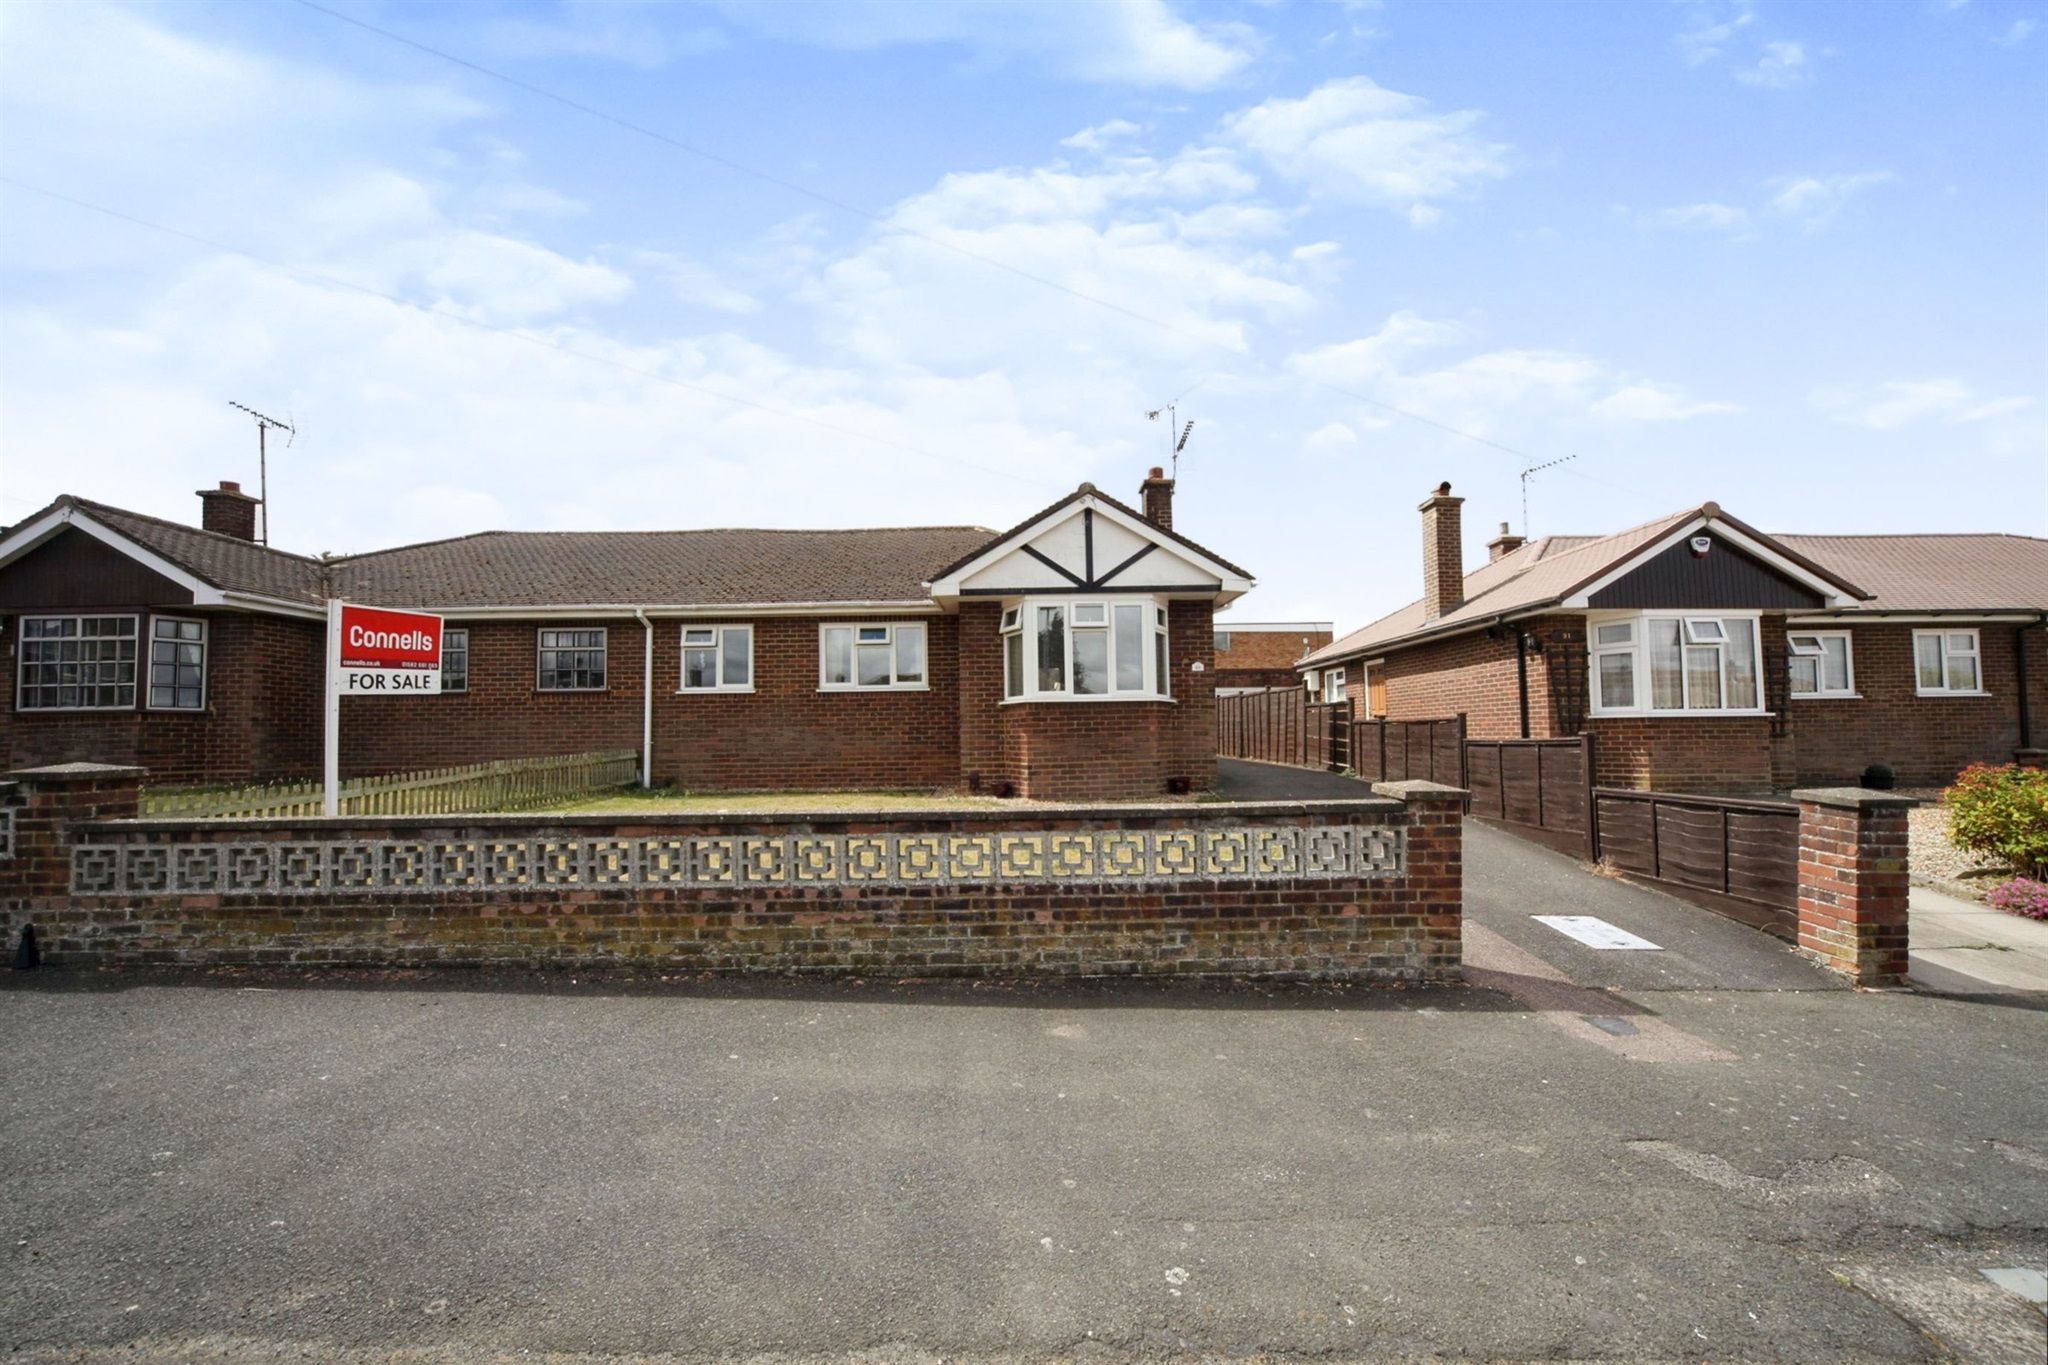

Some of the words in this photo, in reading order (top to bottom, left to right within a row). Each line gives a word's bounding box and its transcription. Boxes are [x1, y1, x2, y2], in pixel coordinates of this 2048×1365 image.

[350, 625, 433, 651] Connells
[349, 673, 386, 689] FOR
[392, 674, 431, 689] SALE
